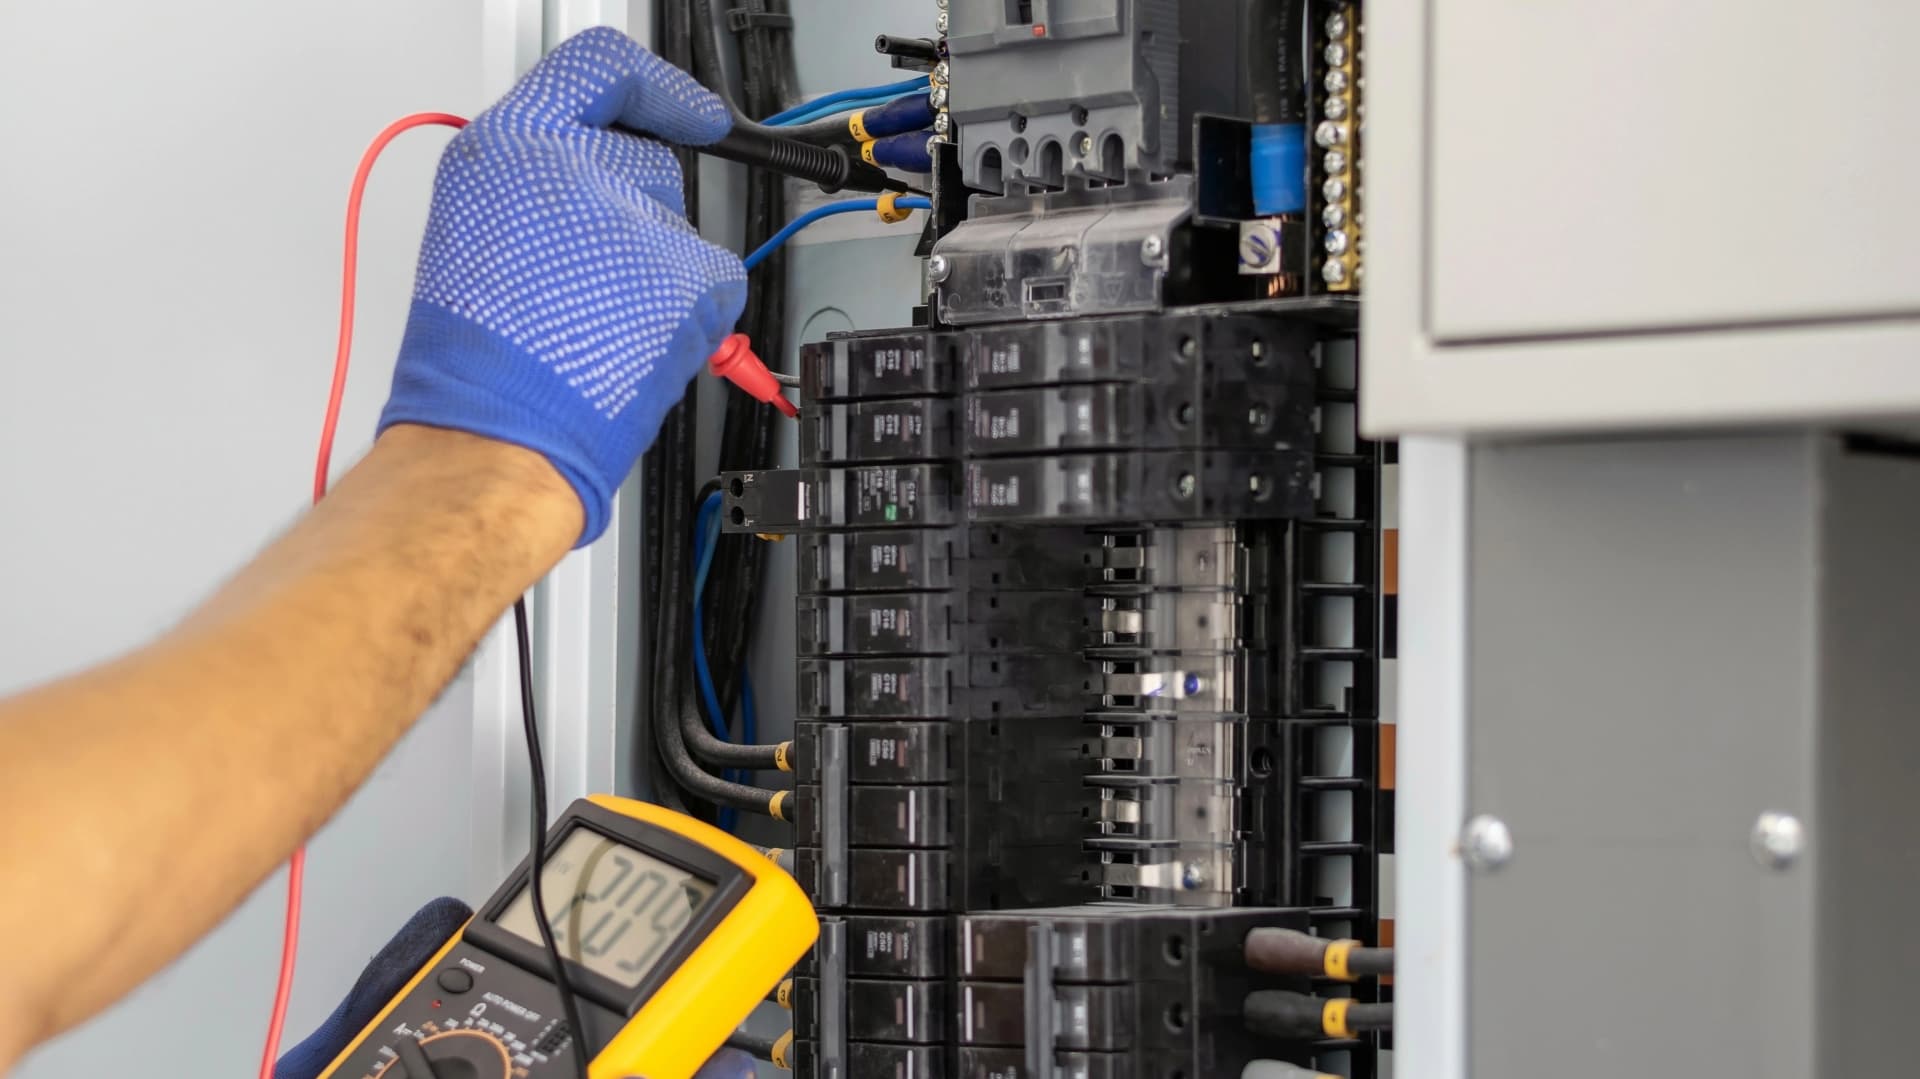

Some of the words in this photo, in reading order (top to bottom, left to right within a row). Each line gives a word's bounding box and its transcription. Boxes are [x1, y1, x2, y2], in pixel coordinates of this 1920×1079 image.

[852, 123, 861, 136] 2
[865, 149, 871, 161] 3
[777, 748, 783, 762] 2
[459, 957, 486, 974] POWER
[780, 989, 786, 1001] 3
[482, 991, 505, 1006] AUTO
[502, 1000, 527, 1017] POWER
[524, 1010, 541, 1022] OFF
